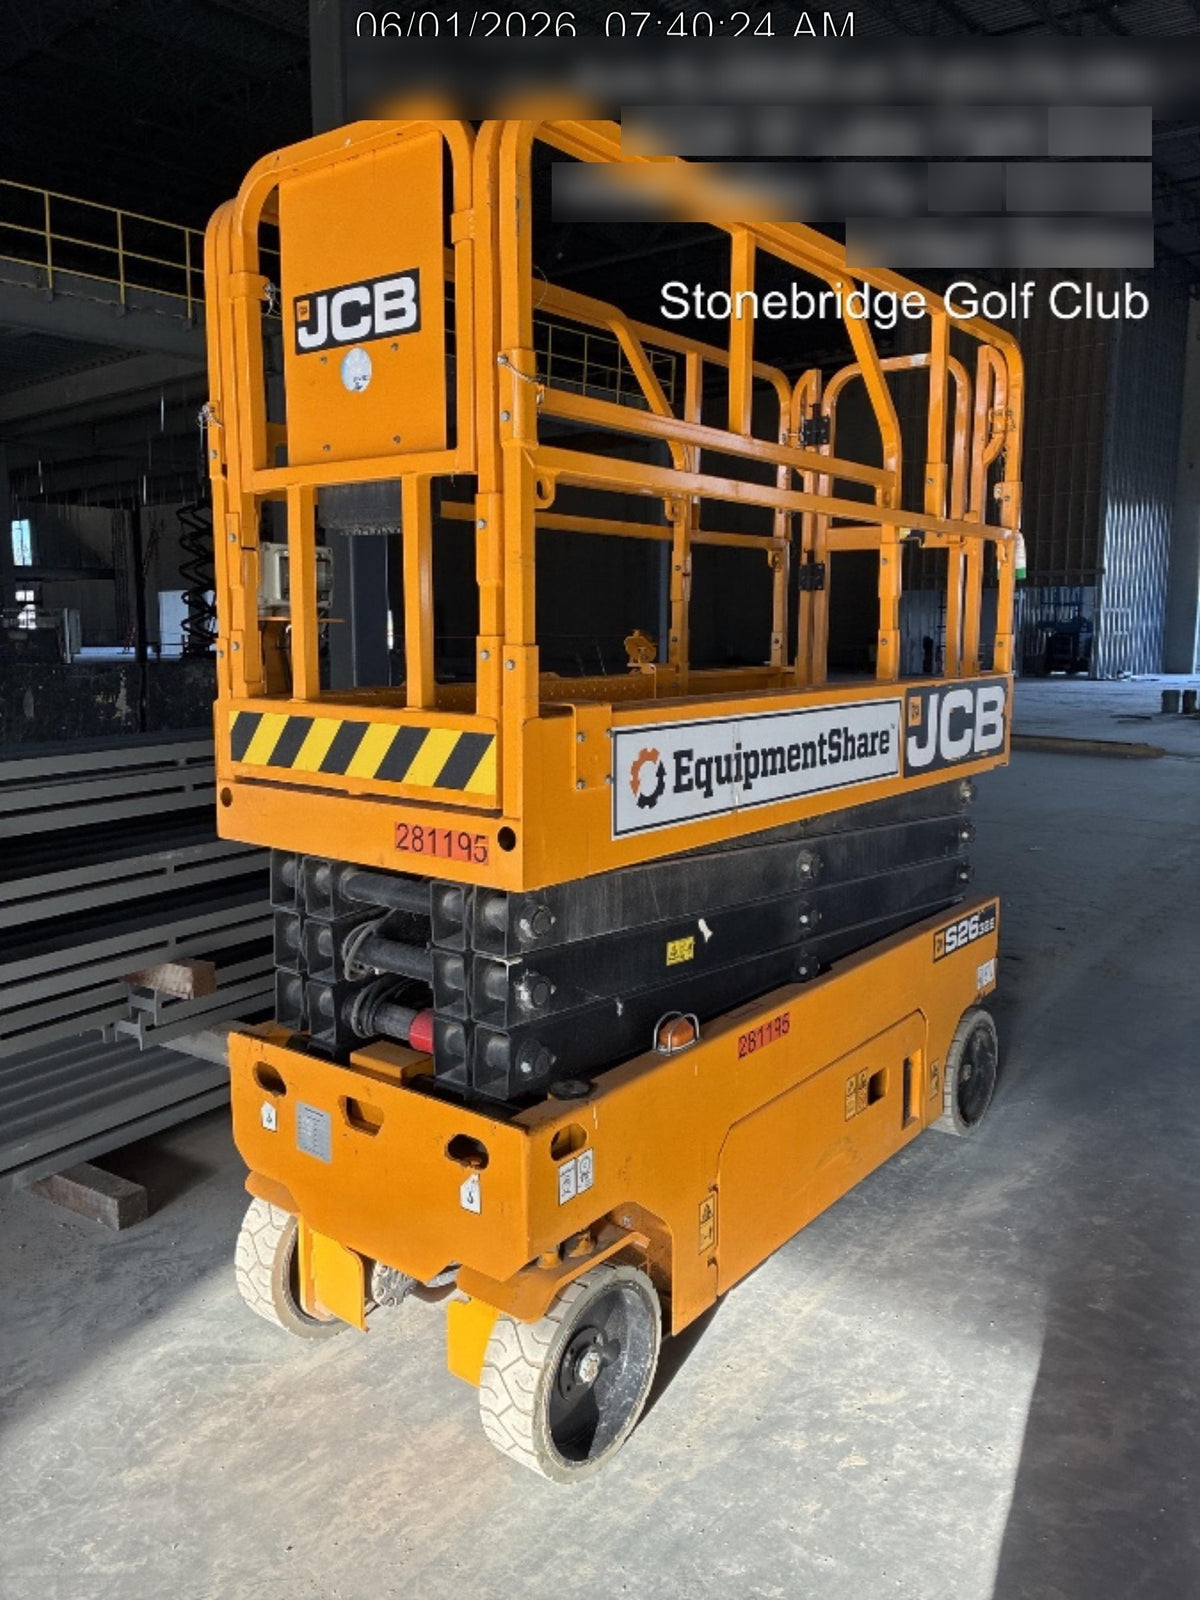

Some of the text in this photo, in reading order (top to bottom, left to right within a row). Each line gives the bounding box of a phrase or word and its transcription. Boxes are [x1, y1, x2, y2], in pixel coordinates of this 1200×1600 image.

[297, 276, 418, 349] JCB
[907, 686, 1005, 767] JCB
[673, 728, 890, 798] EquipmentShare
[396, 823, 487, 863] 281195
[739, 1012, 790, 1059] 281195
